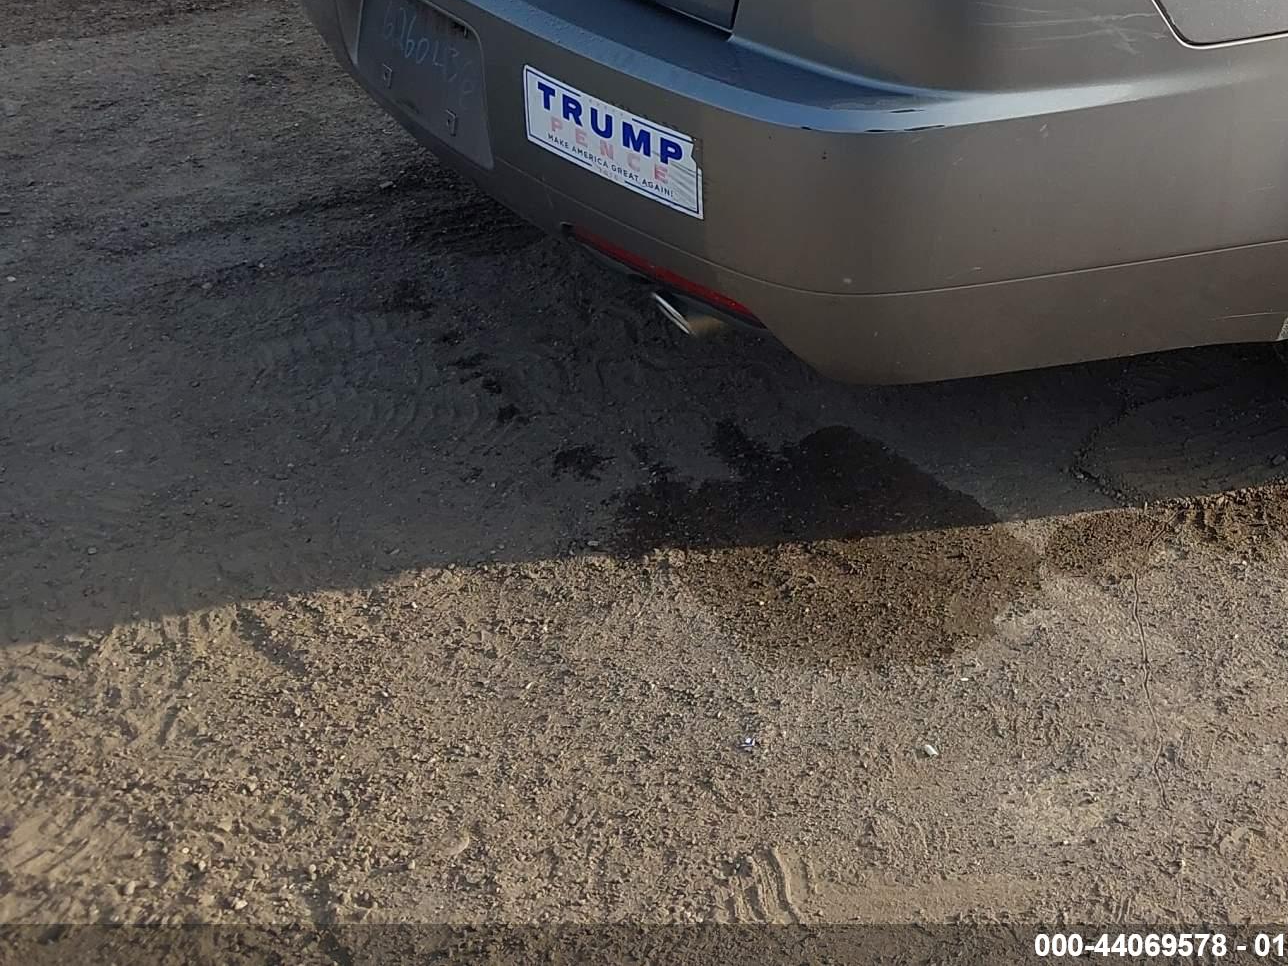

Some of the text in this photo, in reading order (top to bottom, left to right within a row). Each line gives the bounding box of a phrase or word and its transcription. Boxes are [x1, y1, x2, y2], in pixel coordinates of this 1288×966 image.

[537, 81, 683, 165] TRUMP
[551, 116, 669, 183] PENCE
[547, 133, 569, 149] MAKE
[571, 146, 609, 168] AMERICA
[611, 164, 639, 182] GREAT
[641, 179, 674, 198] AGAIN!
